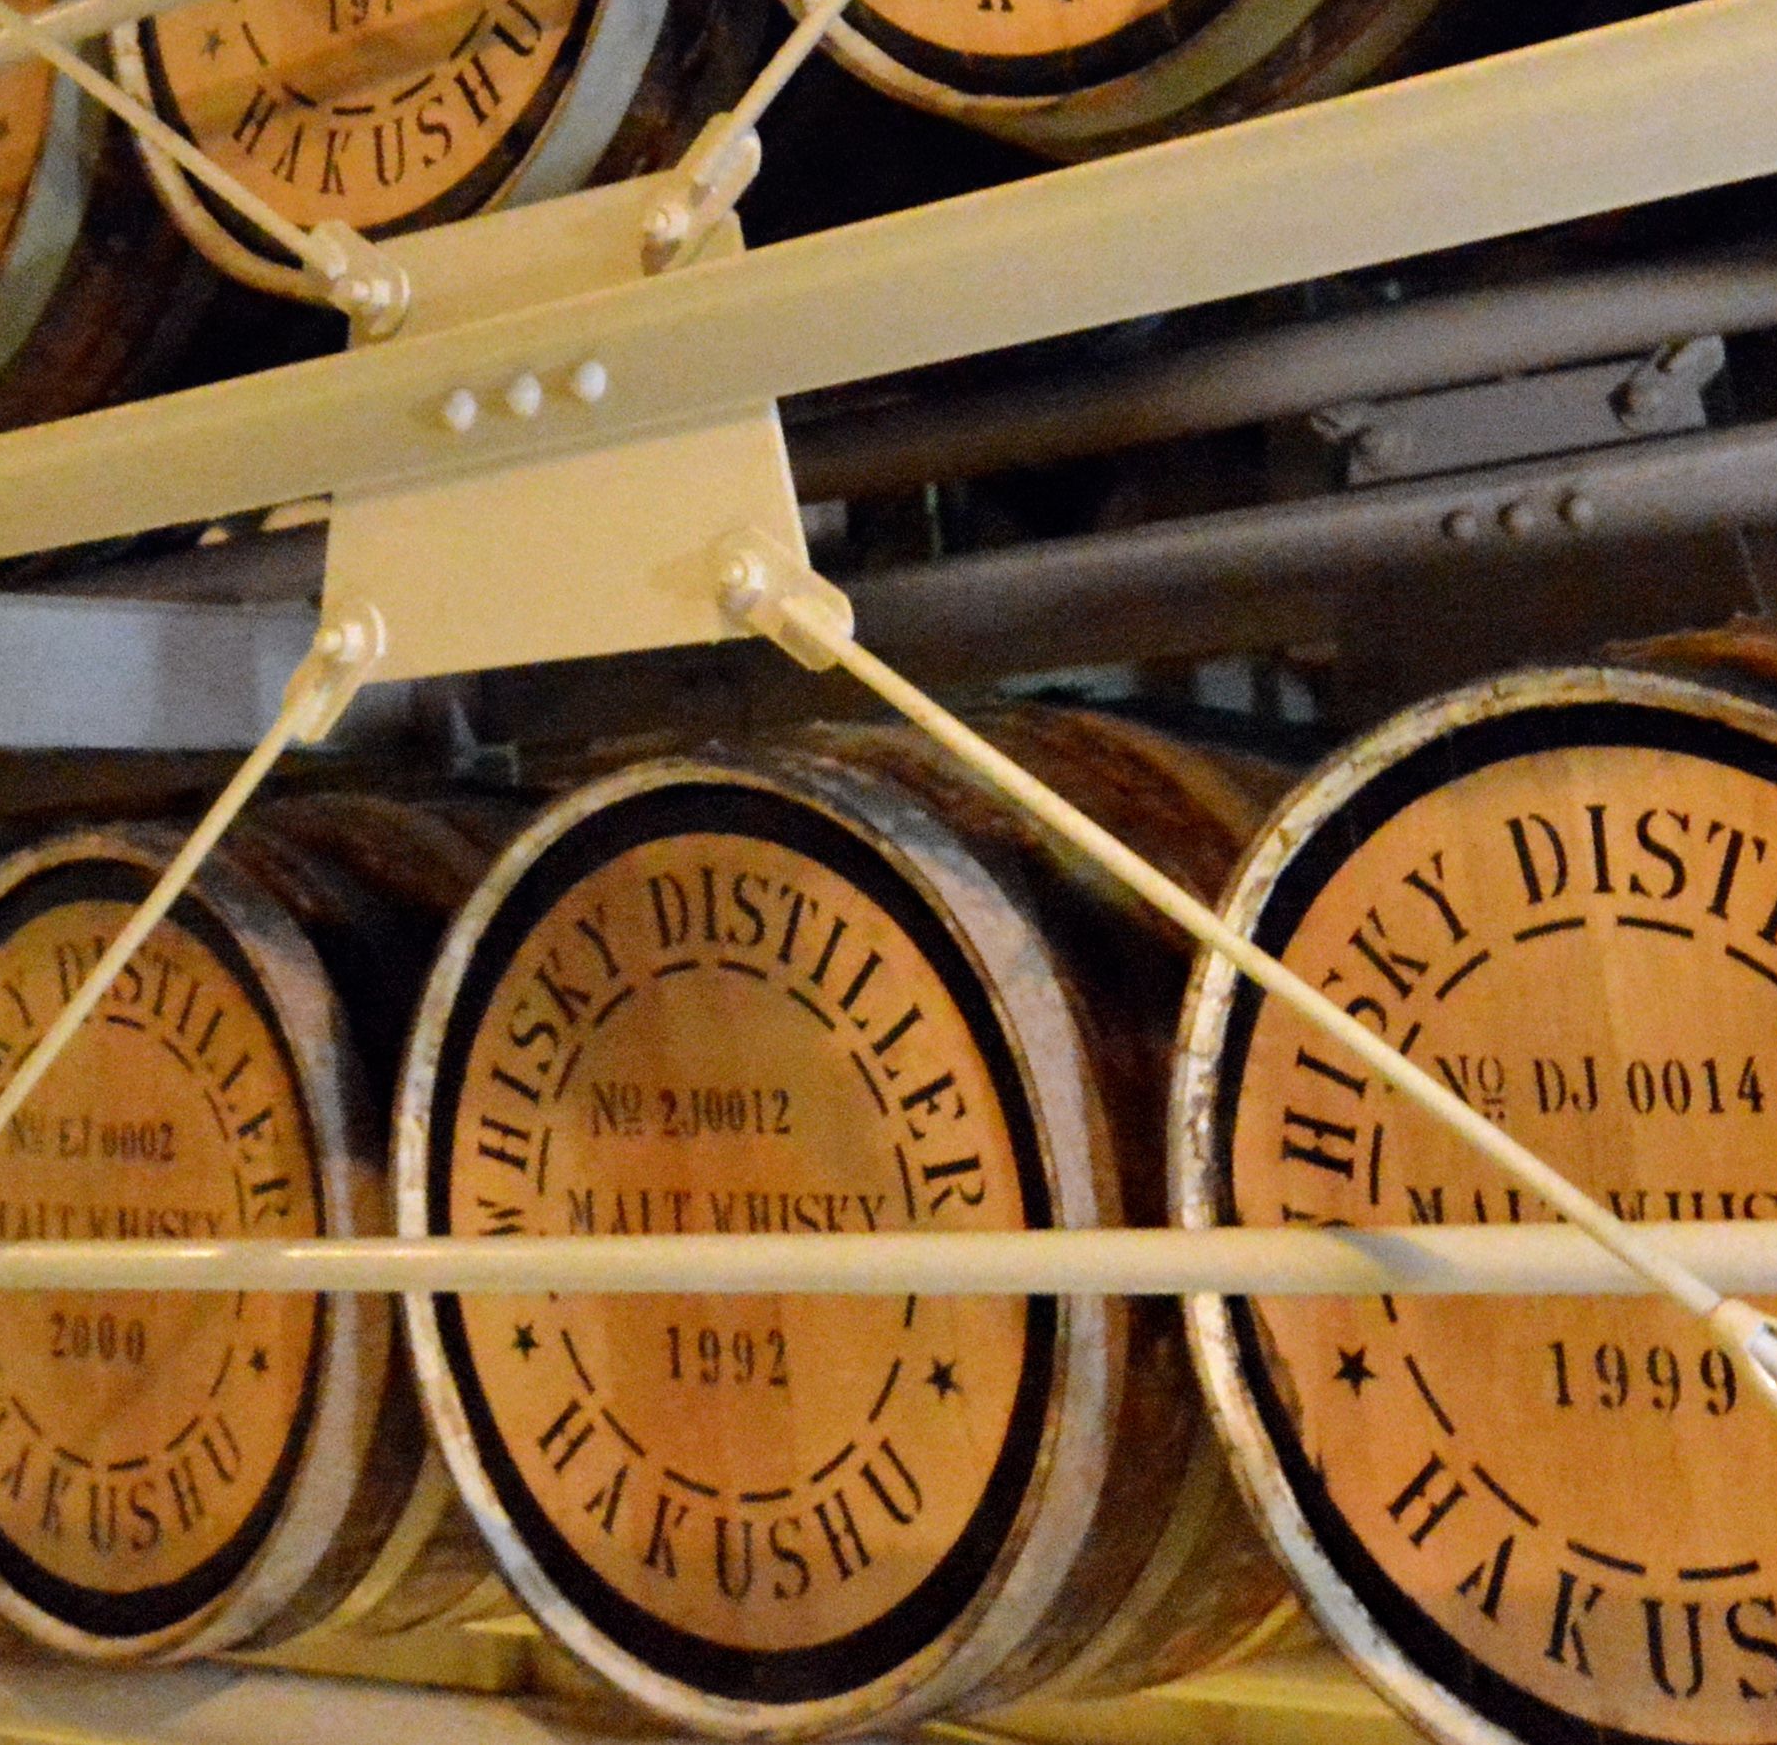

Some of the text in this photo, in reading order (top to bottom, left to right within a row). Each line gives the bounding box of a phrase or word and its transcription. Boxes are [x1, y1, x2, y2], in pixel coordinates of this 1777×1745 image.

[647, 866, 987, 1215] DISTILLER
[1532, 1055, 1600, 1115] DJ
[1625, 1055, 1766, 1117] 0014
[708, 1192, 888, 1235] WHISKY
[666, 1325, 789, 1388] 1992
[1547, 1340, 1741, 1417] 1999
[536, 1397, 928, 1607] HAKUSHU
